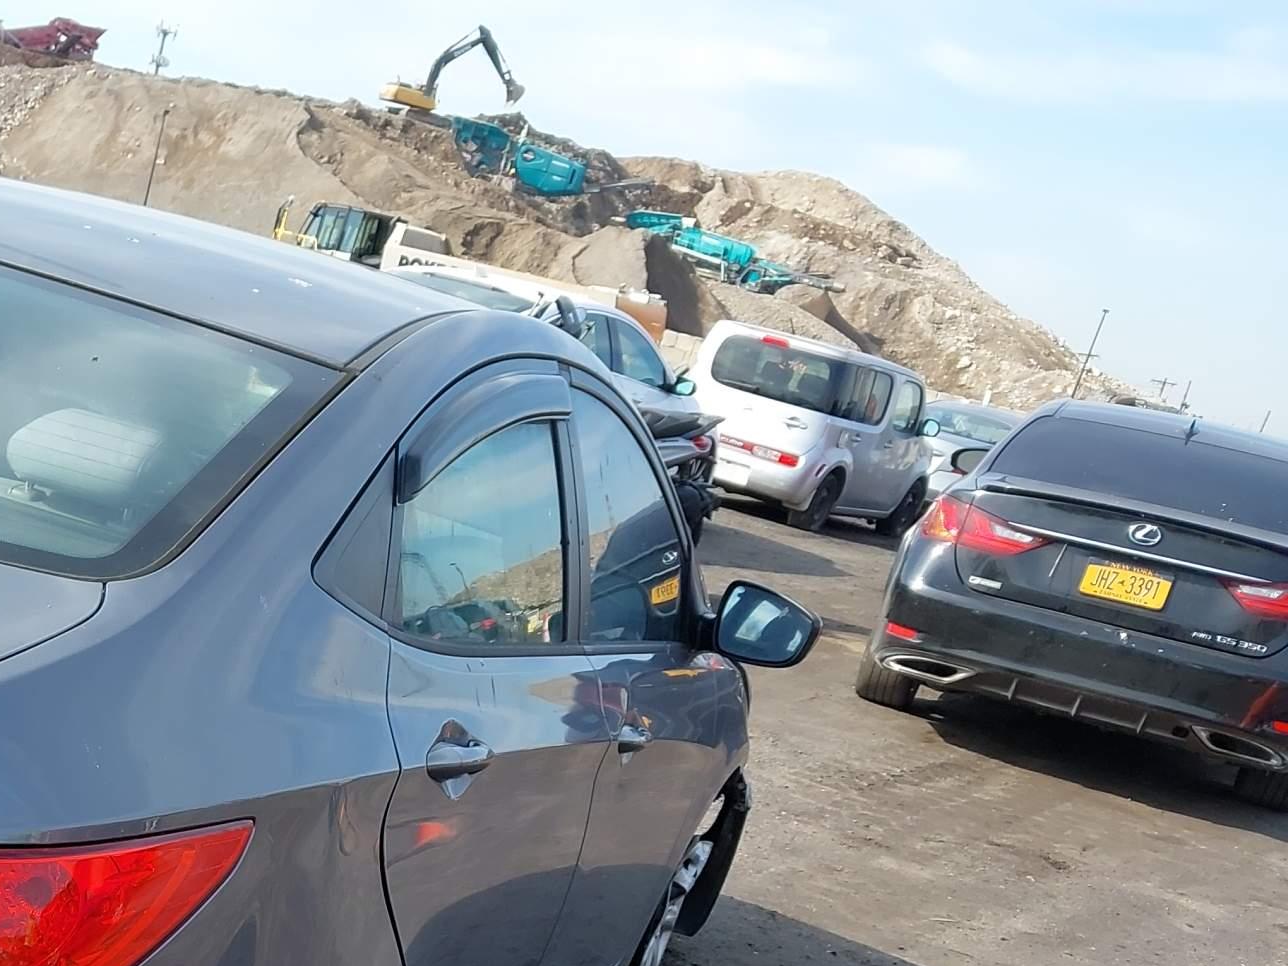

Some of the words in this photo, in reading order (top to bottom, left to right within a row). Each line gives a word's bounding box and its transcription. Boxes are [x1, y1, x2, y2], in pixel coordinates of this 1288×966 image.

[1090, 567, 1120, 591] JHZ
[1125, 575, 1161, 600] 3391
[1238, 640, 1268, 653] 350
